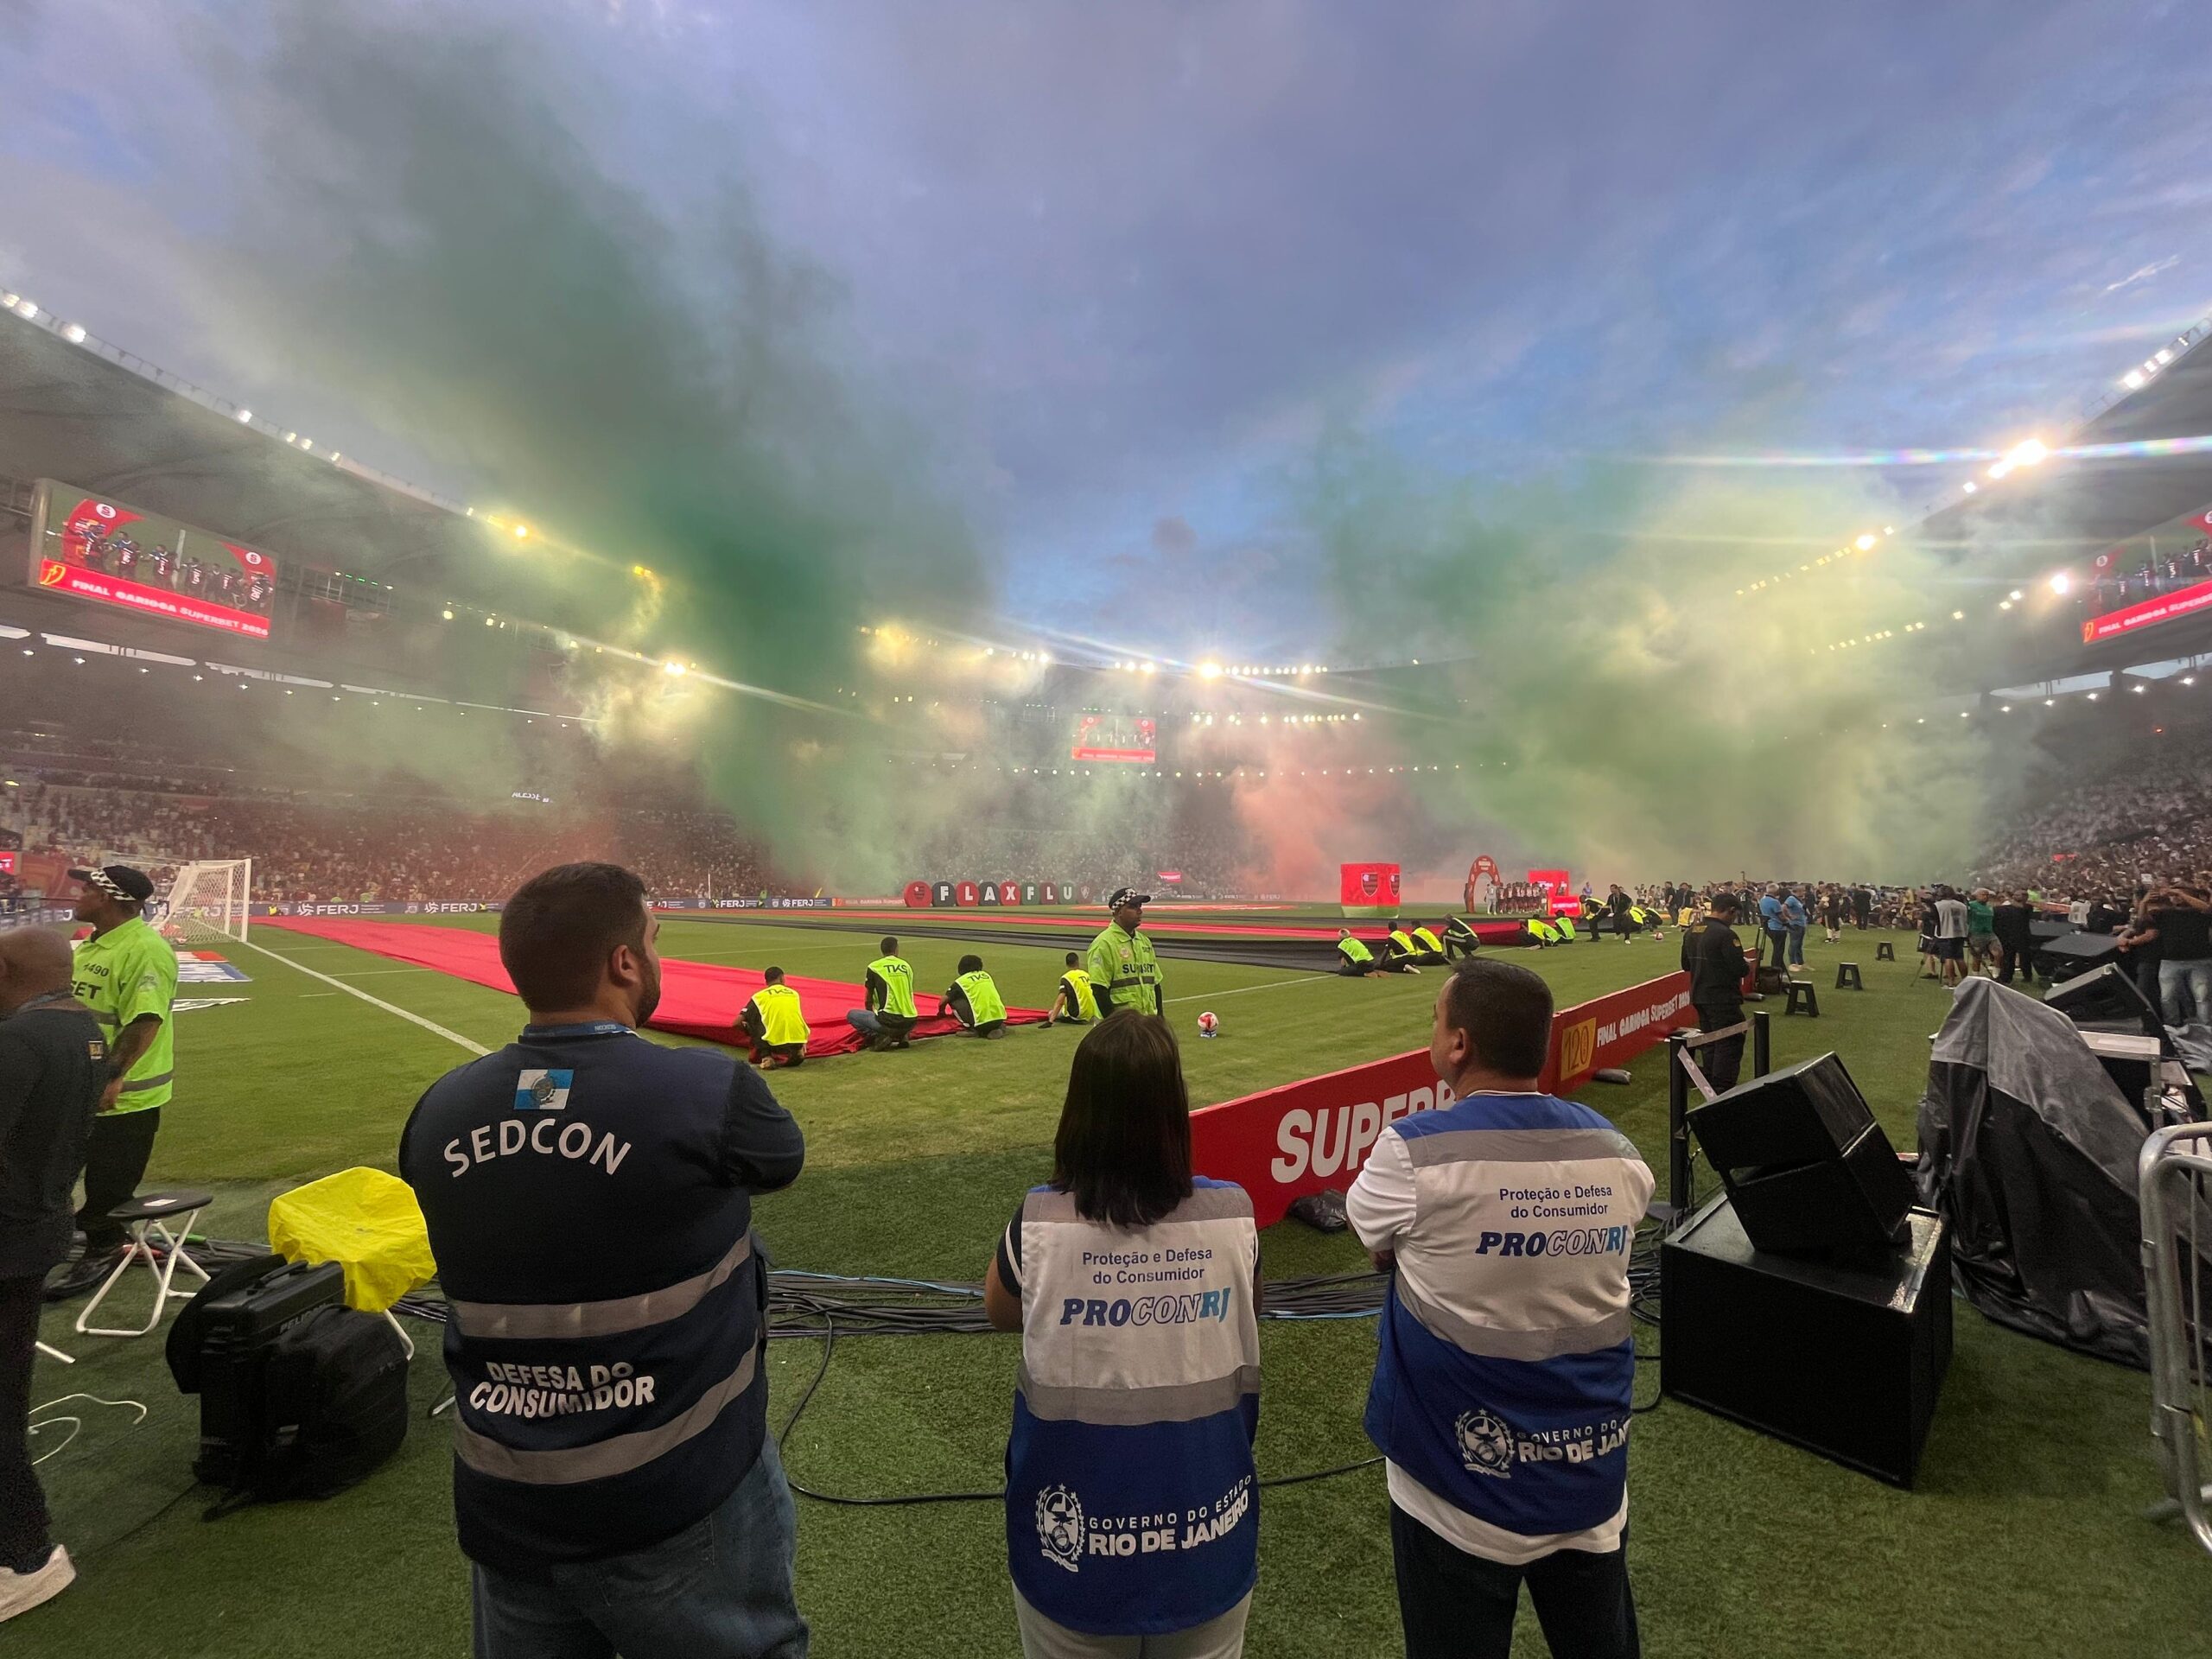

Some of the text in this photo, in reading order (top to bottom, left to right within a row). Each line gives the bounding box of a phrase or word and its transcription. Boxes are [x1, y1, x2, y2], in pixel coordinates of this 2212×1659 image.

[72, 580, 110, 596] FINAL
[180, 607, 239, 628] SUPERBET
[316, 904, 359, 915] FERJ
[441, 902, 478, 912] FERJ
[721, 899, 746, 908] FERJ
[791, 899, 814, 907] FERJ
[883, 964, 908, 974] TKS
[1597, 1021, 1618, 1048] FINAL
[444, 1118, 632, 1178] SEDCON
[1499, 1185, 1612, 1202] Proteção e Defesa
[1510, 1203, 1608, 1218] do Consumidor
[1083, 1248, 1212, 1268] Proteção e Defesa
[1093, 1268, 1205, 1284] do Consumidor
[486, 1361, 633, 1391] DEFESA DO
[469, 1376, 655, 1419] CONSUMIDOR
[1600, 1420, 1618, 1433] DO
[1518, 1441, 1563, 1463] RIO
[1566, 1440, 1594, 1464] DE
[1089, 1475, 1252, 1530] GOVERNO DO ESTADO
[1089, 1489, 1249, 1556] RIO DE JANEIRO
